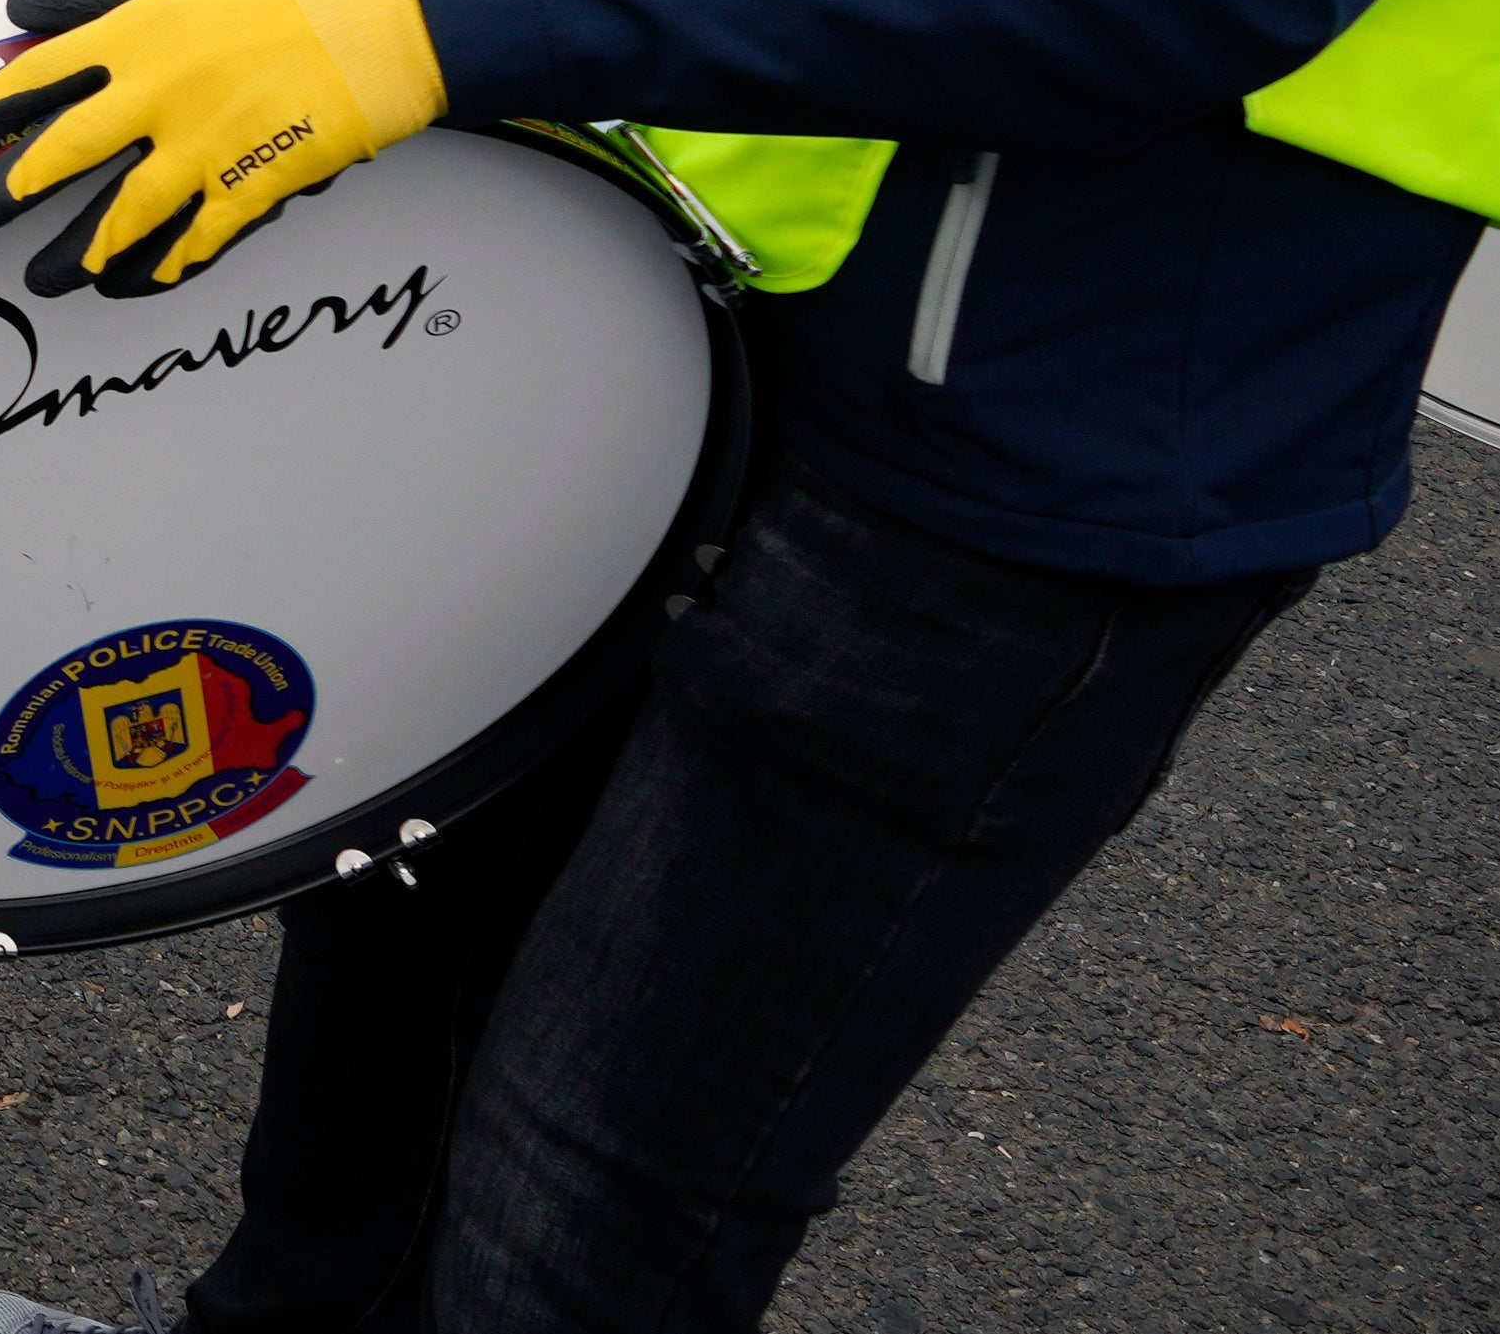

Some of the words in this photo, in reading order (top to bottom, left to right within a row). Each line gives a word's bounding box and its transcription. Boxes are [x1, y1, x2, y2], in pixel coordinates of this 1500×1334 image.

[219, 117, 315, 193] ARDON
[0, 678, 66, 756] Romanian
[60, 628, 209, 683] POLICE
[207, 633, 258, 661] Trade
[255, 650, 290, 693] Union
[134, 831, 205, 859] Dreptate
